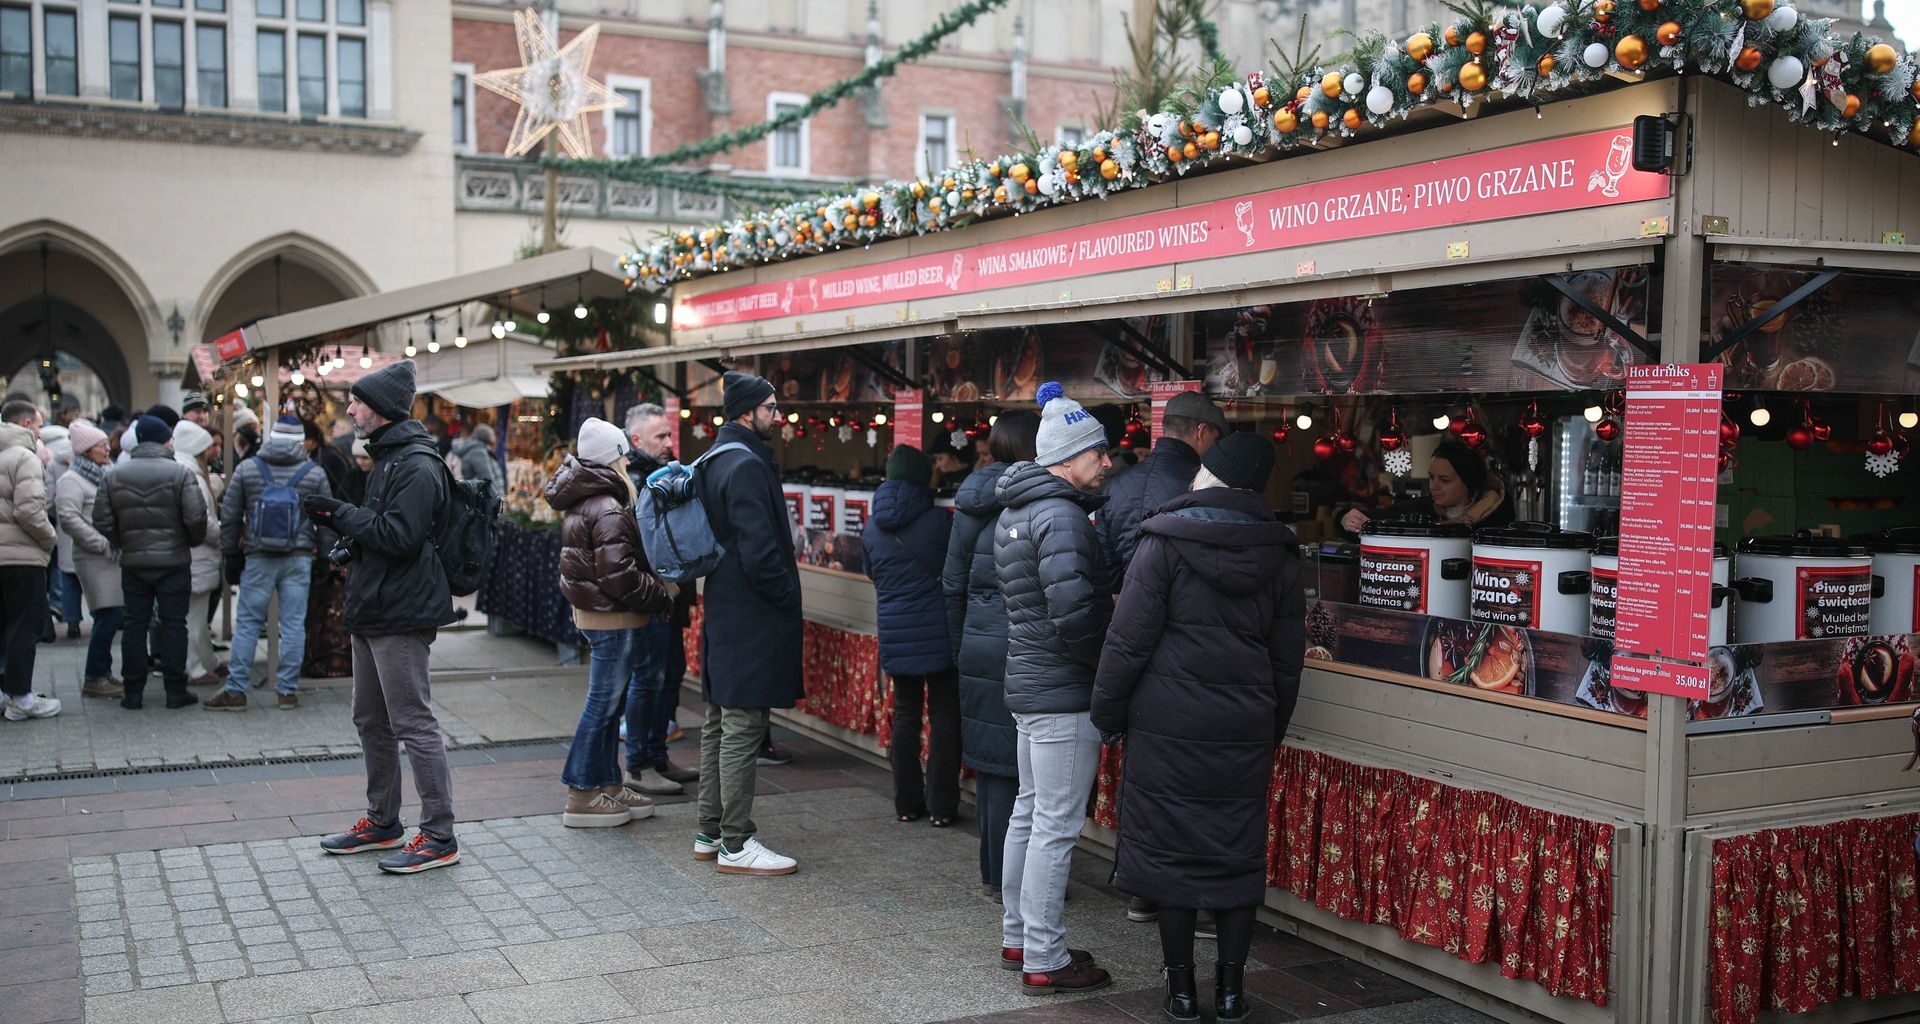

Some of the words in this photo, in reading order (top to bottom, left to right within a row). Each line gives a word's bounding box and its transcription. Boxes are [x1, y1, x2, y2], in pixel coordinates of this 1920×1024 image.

[1269, 201, 1319, 231] WINO
[1324, 187, 1407, 222] GRZANE,
[1414, 176, 1470, 208] PIWO
[1477, 159, 1575, 199] GRZANE
[978, 254, 1007, 276] WINA
[1009, 244, 1067, 271] SMAKOWE
[1069, 242, 1077, 268] /
[1079, 230, 1154, 260] FLAVOURED
[1158, 221, 1208, 249] WINES
[822, 279, 855, 300] MULLED
[855, 275, 880, 294] WINE,
[882, 270, 917, 291] MULLED
[918, 266, 943, 285] BEER
[759, 292, 778, 308] BEER
[1629, 367, 1649, 377] Hot
[1652, 366, 1690, 377] drinks
[1152, 384, 1163, 392] Hot
[1376, 562, 1414, 571] grzane
[1474, 571, 1510, 588] Wino
[1361, 585, 1381, 595] Mulled
[1384, 588, 1405, 596] wine
[1816, 583, 1846, 593] Piwo
[1362, 595, 1401, 606] Christmas
[1472, 589, 1518, 604] grzane
[1492, 612, 1516, 621] wine
[1593, 615, 1615, 626] Mulled
[1823, 613, 1855, 623] Mulled
[1592, 626, 1615, 637] Christma
[1614, 664, 1636, 673] Czekolada
[1642, 668, 1657, 676] gorąco
[1676, 675, 1697, 687] 35,00
[1699, 678, 1706, 688] zł
